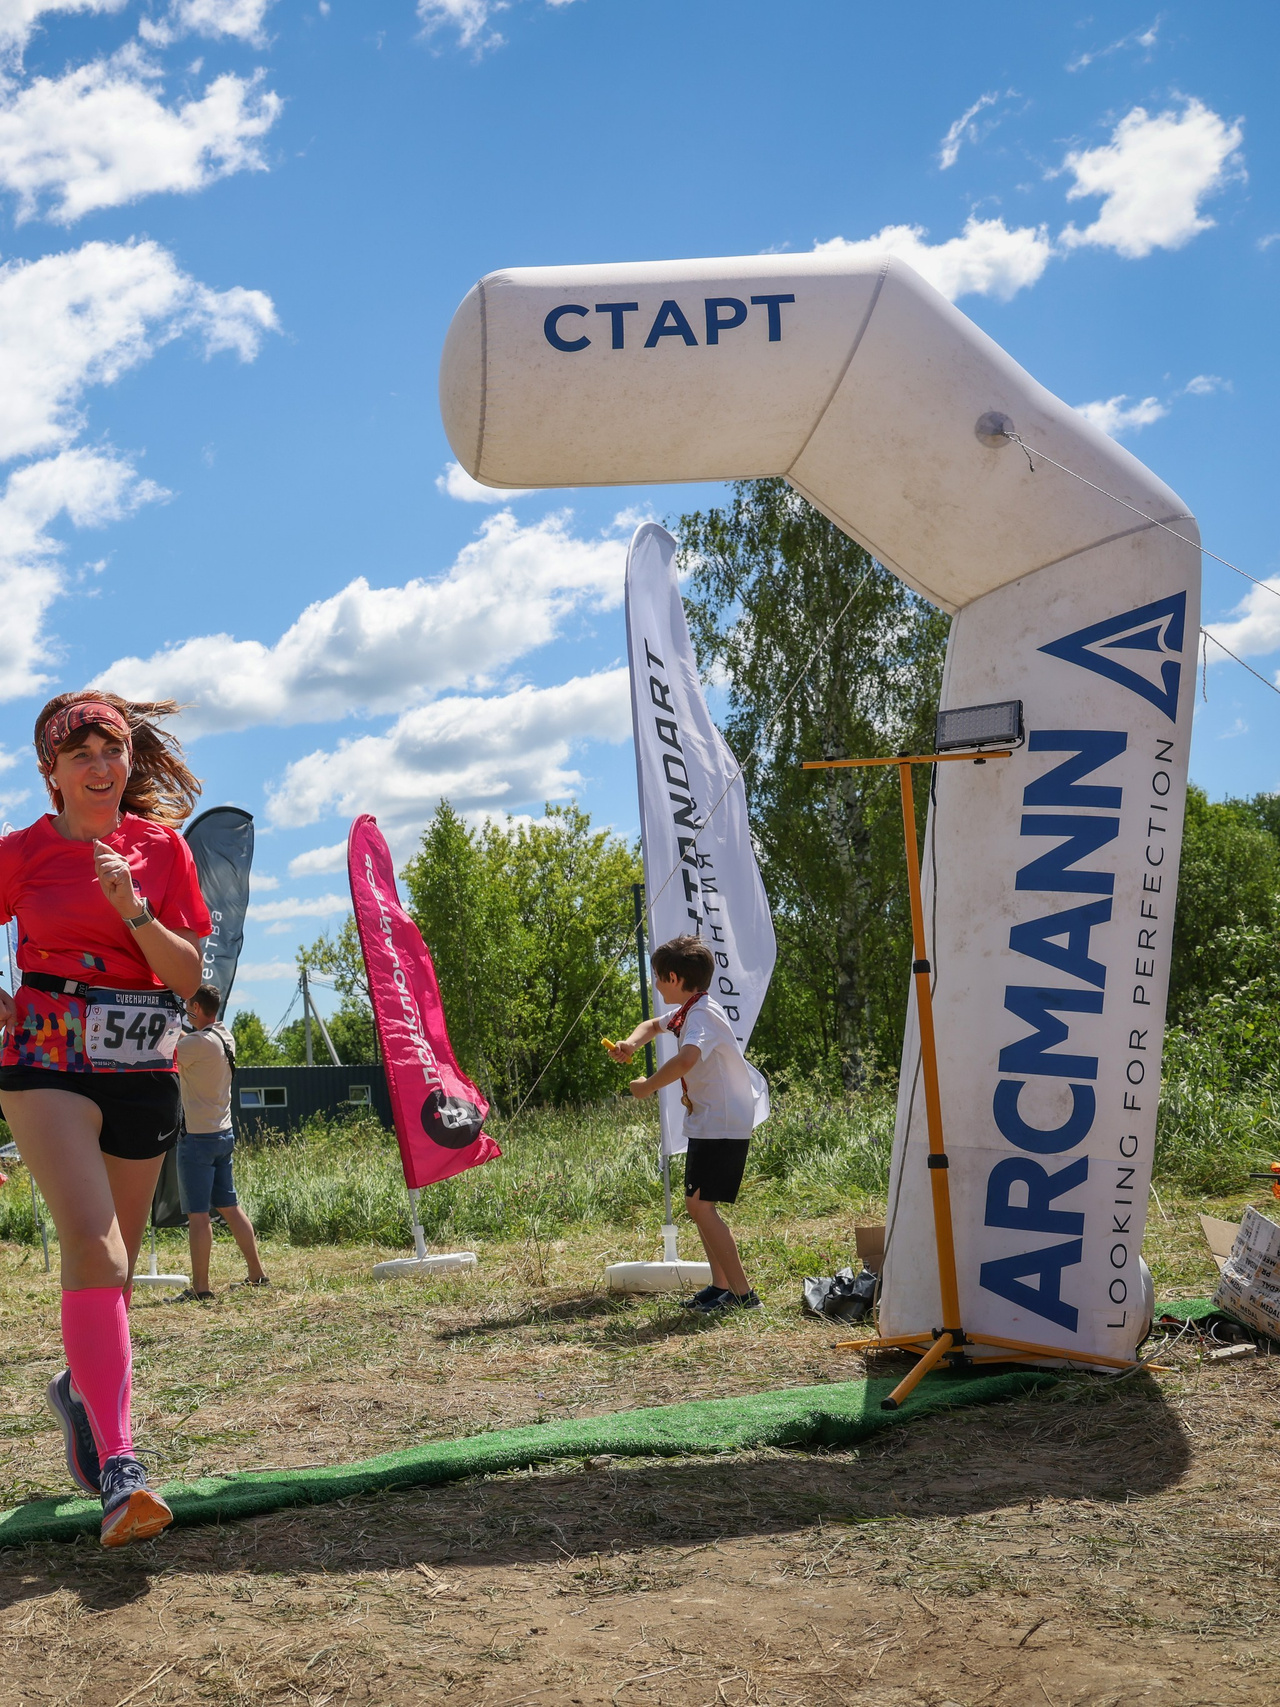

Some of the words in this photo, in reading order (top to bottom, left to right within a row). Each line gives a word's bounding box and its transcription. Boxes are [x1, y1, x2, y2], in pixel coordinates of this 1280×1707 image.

[543, 293, 795, 353] СТАРТ
[643, 637, 703, 937] TANDART
[1133, 738, 1174, 1005] PERFECTION
[202, 910, 222, 980] ества
[104, 1010, 166, 1051] 549
[979, 729, 1128, 1334] ARCMANN
[1123, 1029, 1148, 1111] FOR
[1107, 1135, 1138, 1328] LOOKING
